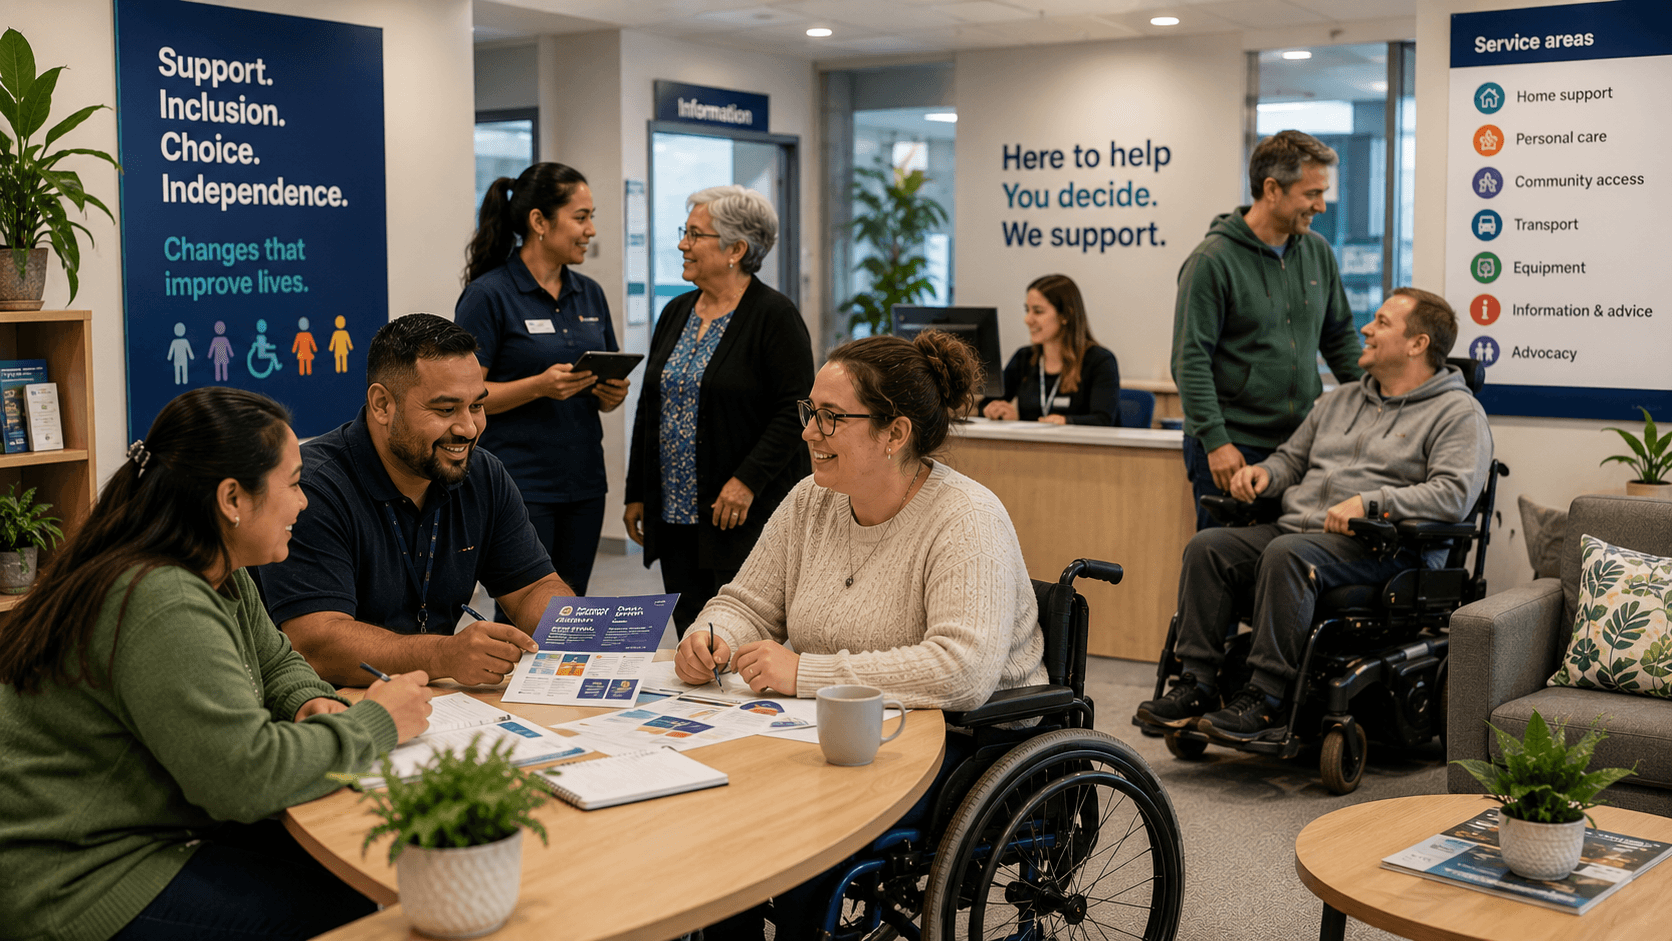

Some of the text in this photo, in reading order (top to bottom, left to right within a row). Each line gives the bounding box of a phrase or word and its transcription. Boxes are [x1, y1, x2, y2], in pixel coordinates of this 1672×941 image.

[1475, 33, 1594, 53] Service areas
[158, 46, 274, 88] Support.
[160, 89, 286, 127] Inclusion.
[1517, 86, 1613, 104] Home support
[677, 97, 753, 125] Information
[161, 132, 260, 164] Choice.
[1516, 130, 1608, 146] Personal care
[1002, 139, 1172, 173] Here to help
[163, 174, 348, 211] Independence.
[1001, 180, 1158, 209] You decide.
[1515, 173, 1645, 190] Community access
[1002, 221, 1166, 254] We support.
[1514, 218, 1579, 234] Transport
[164, 236, 306, 266] Changes that
[1513, 260, 1586, 277] Equipment
[165, 269, 308, 301] improve lives.
[1512, 303, 1653, 318] Information & advice
[1511, 345, 1578, 363] Advocacy
